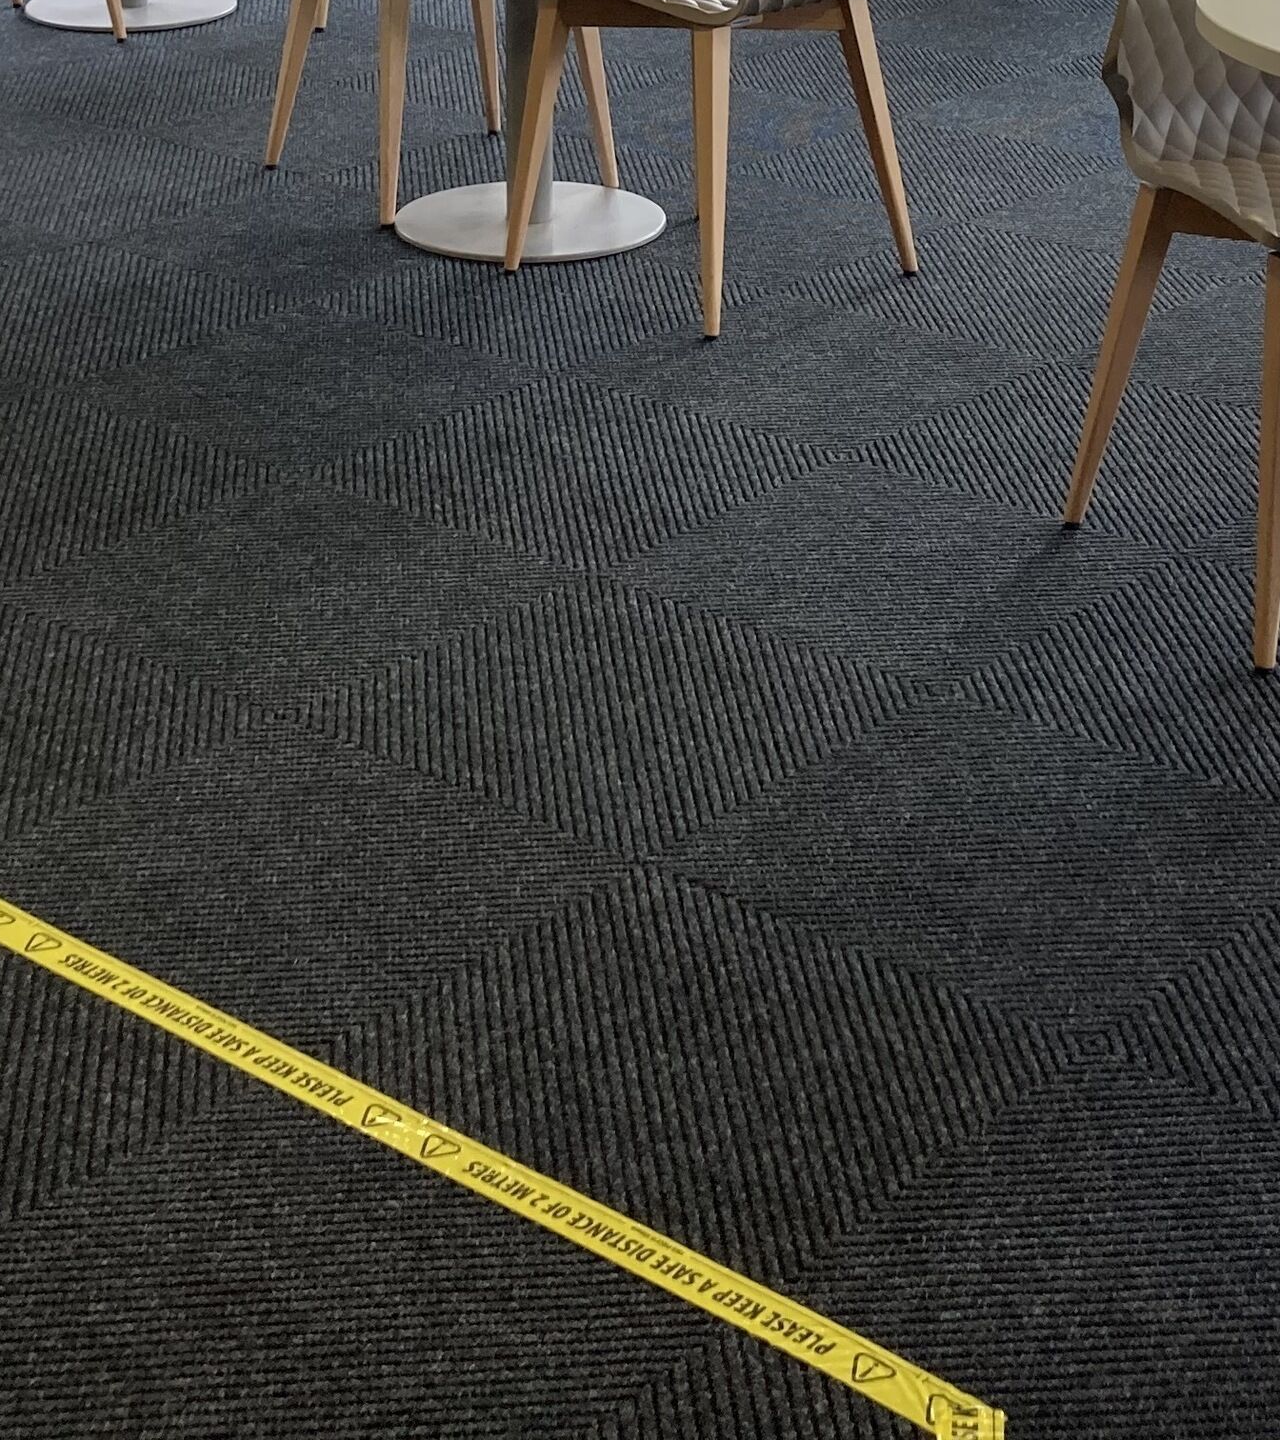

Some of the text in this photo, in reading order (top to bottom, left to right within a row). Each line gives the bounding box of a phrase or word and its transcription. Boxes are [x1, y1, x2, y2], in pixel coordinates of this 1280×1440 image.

[58, 953, 120, 985] METRES
[111, 979, 131, 990] 2
[121, 985, 148, 999] OF
[139, 994, 214, 1034] DISTANCE
[205, 1028, 249, 1052] SAFE
[242, 1046, 262, 1057] A
[253, 1055, 299, 1079] KEEP
[290, 1071, 355, 1107] PLEASE
[462, 1161, 536, 1200] METRES
[530, 1193, 550, 1207] 2
[541, 1201, 572, 1219] OF
[566, 1211, 657, 1262] DISTANCE
[649, 1255, 703, 1286] SAFE
[697, 1278, 718, 1293] A
[711, 1289, 767, 1320] KEEP
[760, 1310, 837, 1355] PLEASE
